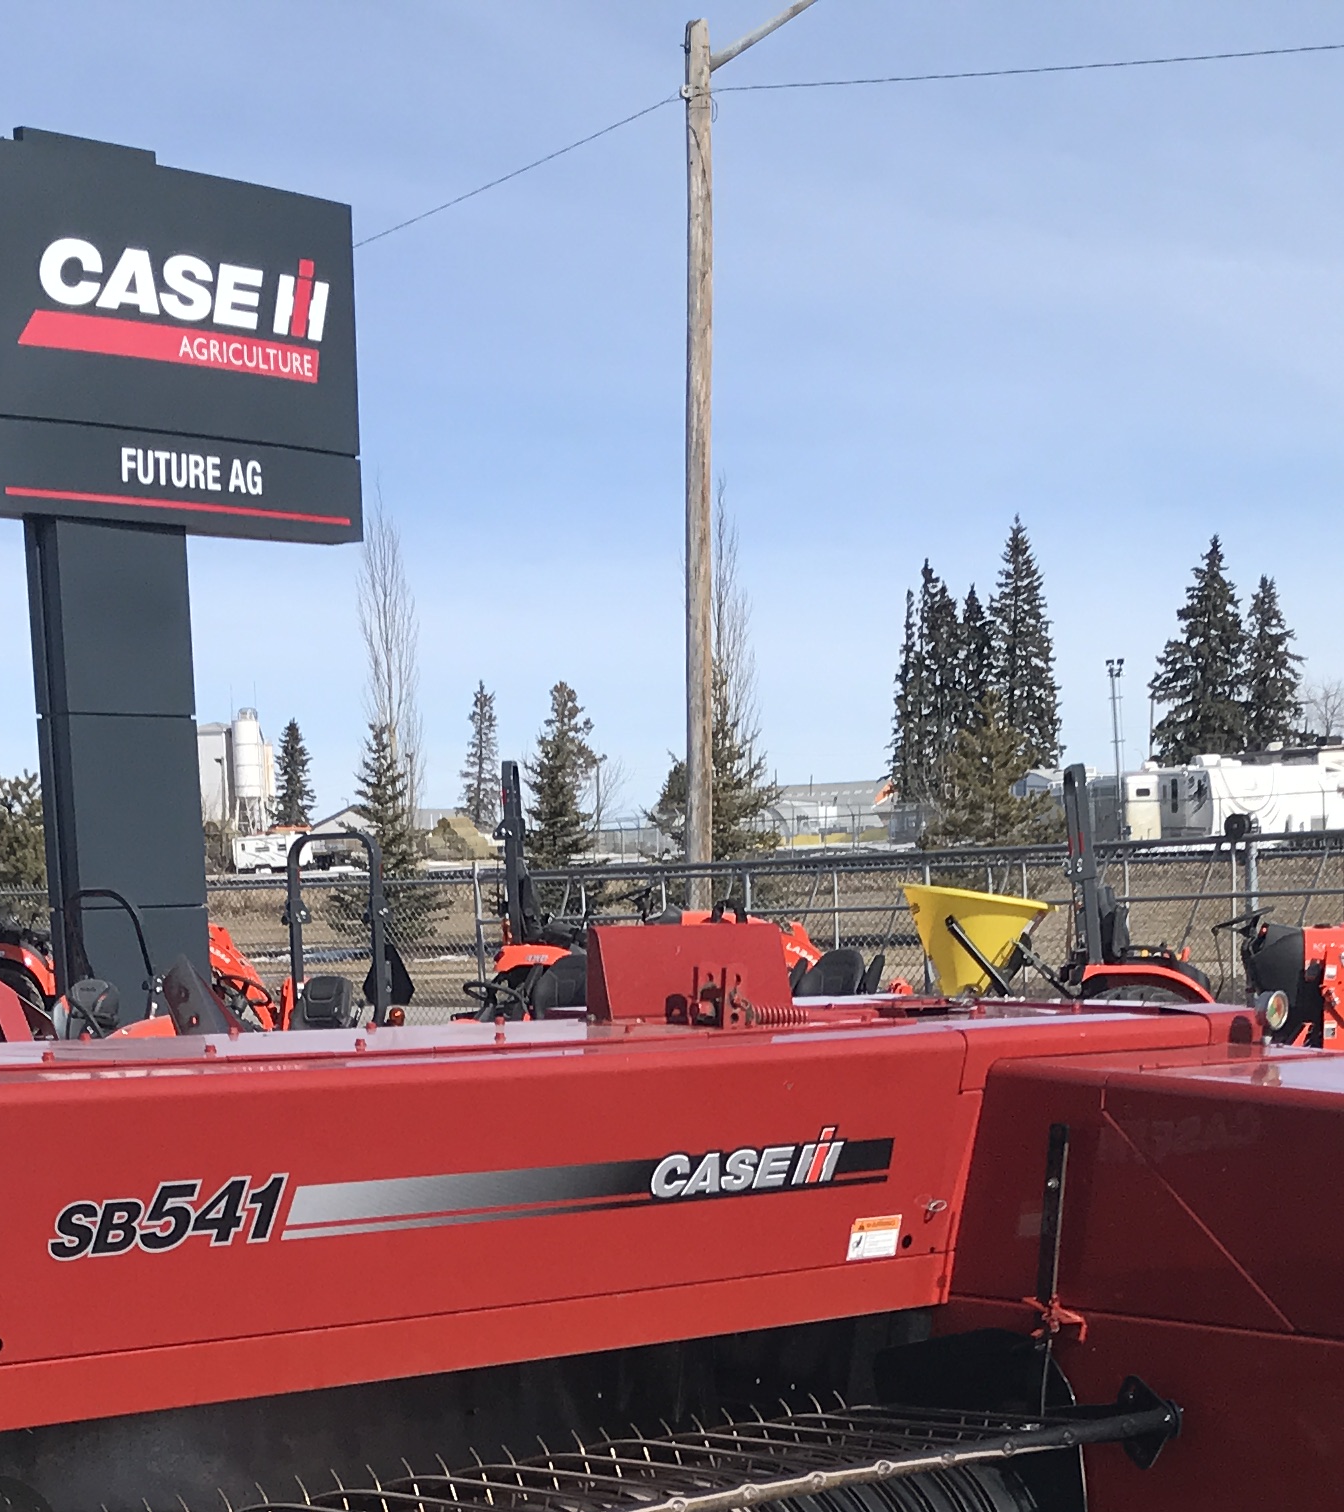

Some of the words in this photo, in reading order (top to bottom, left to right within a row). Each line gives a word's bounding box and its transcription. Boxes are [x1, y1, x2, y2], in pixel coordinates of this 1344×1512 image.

[39, 237, 263, 330] CASE
[179, 335, 314, 378] AGRICULTURE
[121, 447, 222, 491] FUTURE
[228, 457, 263, 496] AG
[650, 1145, 795, 1199] CASE
[48, 1172, 289, 1262] SB541
